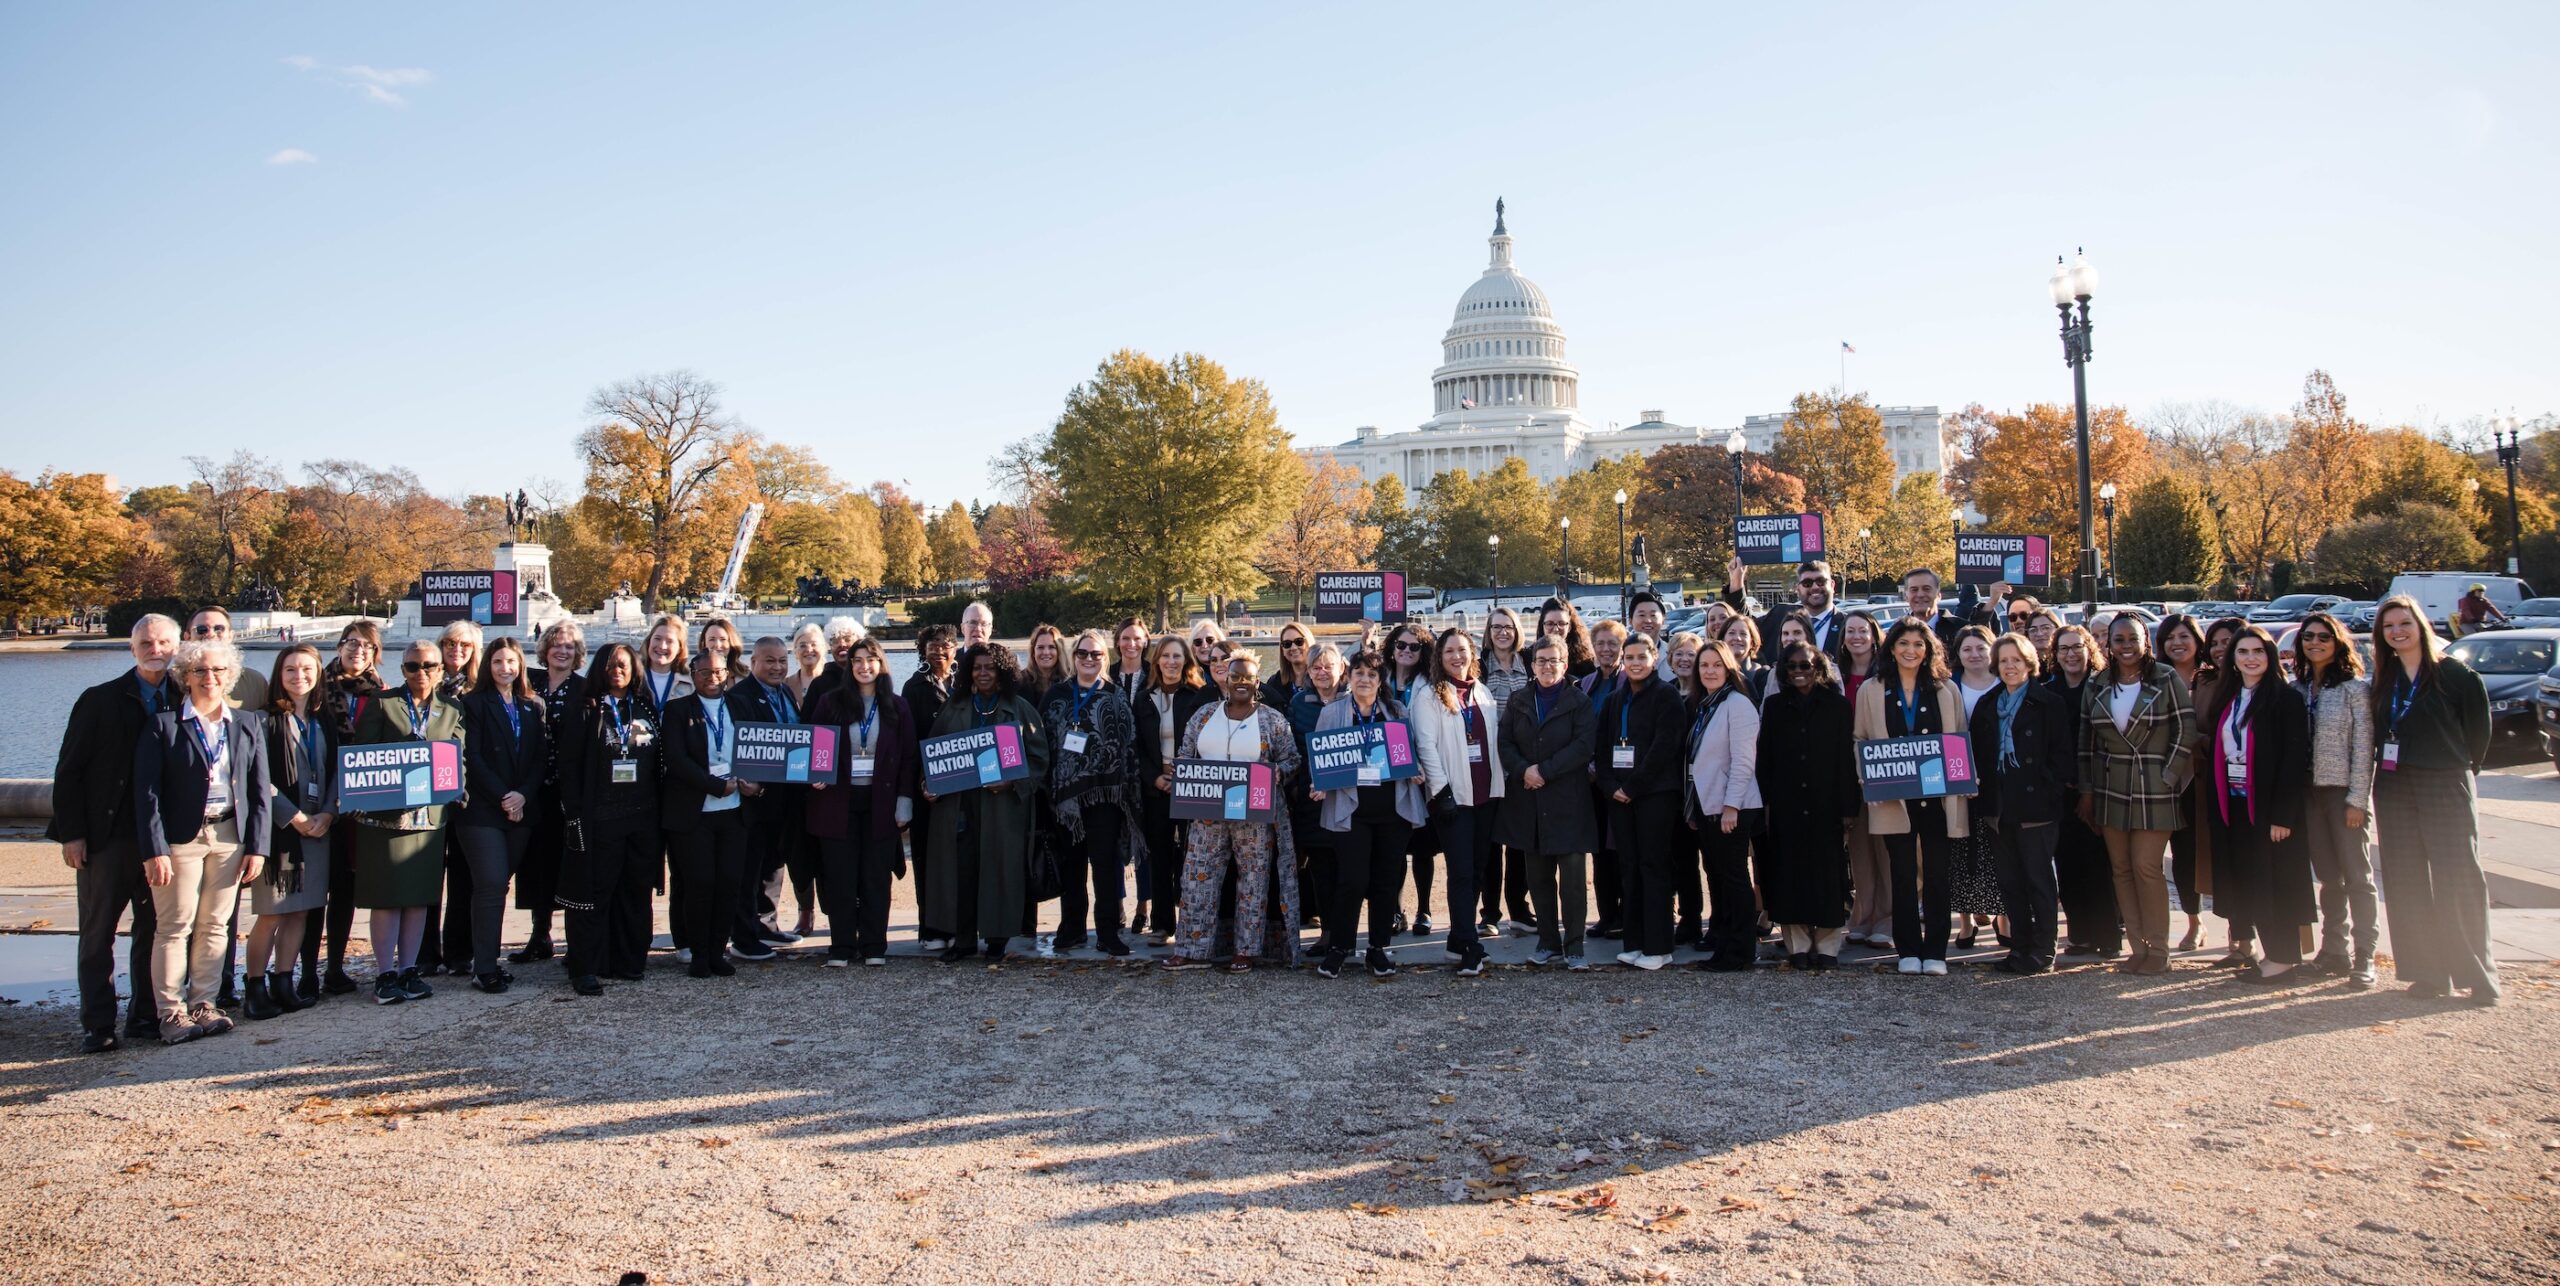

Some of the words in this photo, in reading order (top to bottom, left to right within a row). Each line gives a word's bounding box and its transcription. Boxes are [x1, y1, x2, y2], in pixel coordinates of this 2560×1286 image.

[1737, 518, 1799, 532] CAREGIVER
[1738, 534, 1779, 547] NATION
[1960, 539, 2024, 551] CAREGIVER
[1960, 554, 2001, 566] NATION
[2029, 556, 2041, 564] 20
[426, 576, 491, 589] CAREGIVER
[1320, 577, 1382, 588] CAREGIVER
[426, 593, 469, 606] NATION
[497, 594, 509, 602] 20
[1320, 592, 1361, 604] NATION
[497, 602, 509, 611] 24
[1388, 601, 1399, 609] 24
[738, 727, 811, 744] CAREGIVER
[1311, 728, 1384, 751] CAREGIVR
[925, 731, 995, 758] CAREGIVER
[1392, 744, 1405, 753] 20
[1863, 740, 1941, 760] CAREGIVER
[737, 745, 785, 760] NATION
[816, 750, 829, 758] 20
[1002, 746, 1015, 756] 20
[344, 747, 430, 768] CAREGIVER
[816, 759, 828, 767] 24
[1005, 755, 1016, 765] 24
[1314, 749, 1363, 769] NATION
[1394, 753, 1407, 762] 24
[1949, 759, 1963, 768] 20
[928, 753, 975, 775] NATION
[1865, 761, 1917, 779] NATION
[437, 767, 452, 776] 20
[1176, 764, 1247, 781] CAREGIVER
[1951, 768, 1964, 778] 24
[345, 769, 402, 788] NATION
[438, 778, 452, 787] 24
[1175, 782, 1222, 798] NATION
[1253, 788, 1266, 796] 20
[1252, 797, 1265, 806] 24
